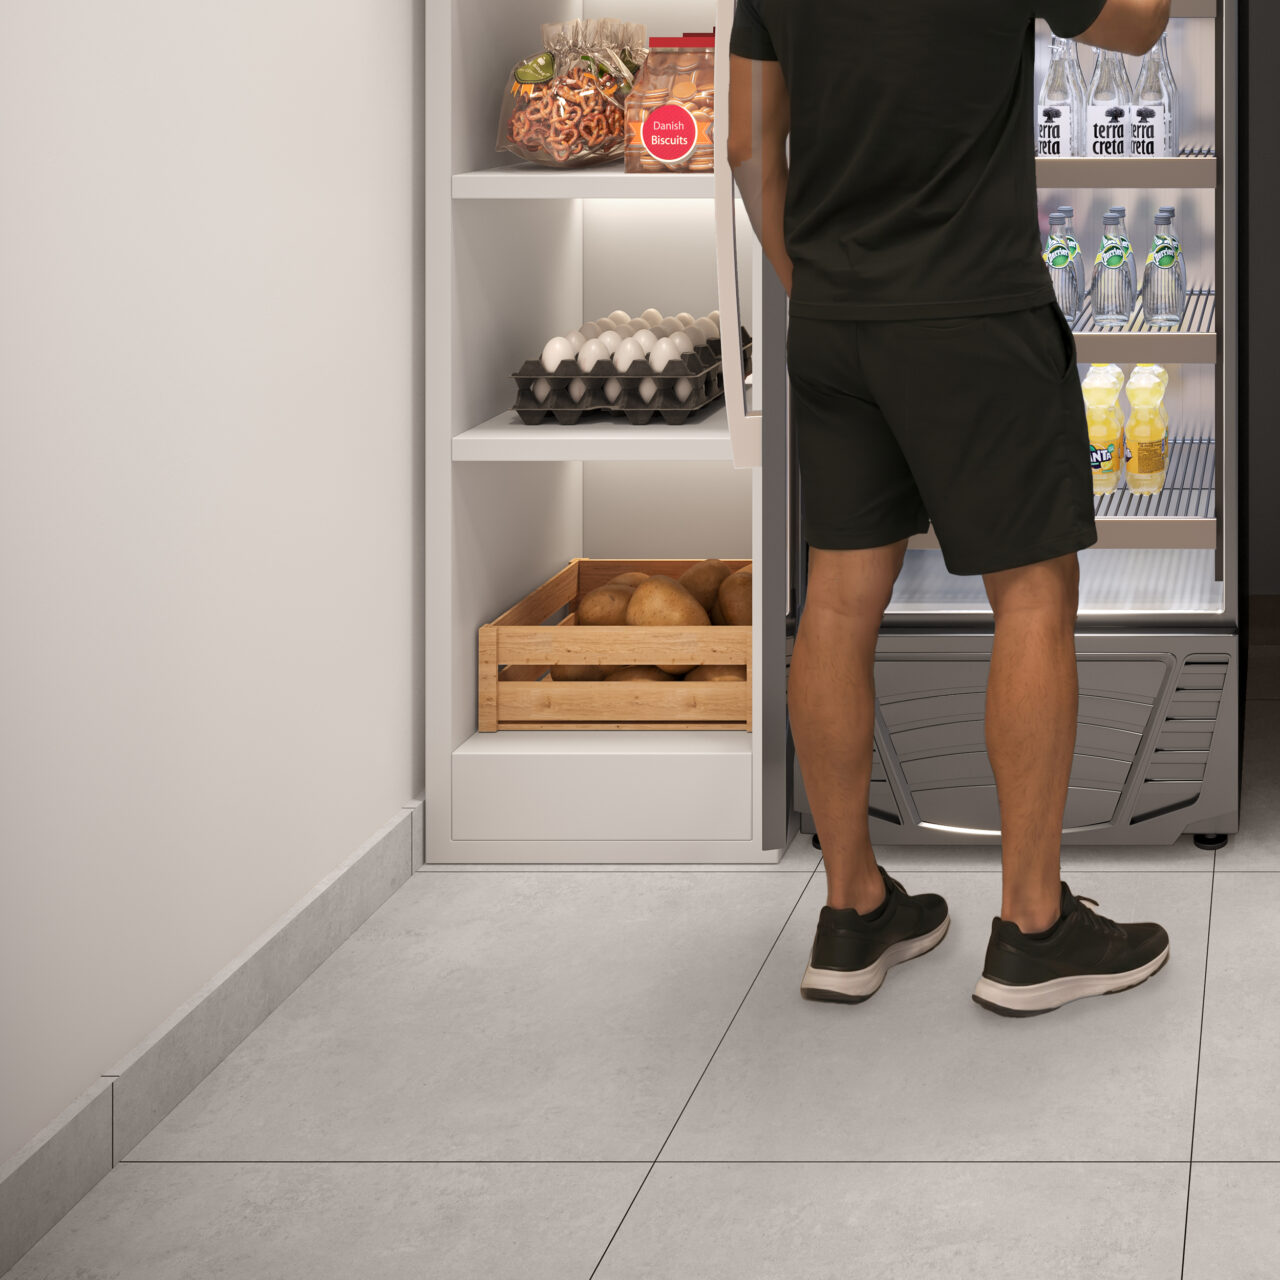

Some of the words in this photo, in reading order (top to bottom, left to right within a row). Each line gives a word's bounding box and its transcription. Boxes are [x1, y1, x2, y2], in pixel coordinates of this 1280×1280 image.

[653, 121, 685, 130] Danish
[1093, 123, 1124, 139] terra
[651, 135, 688, 145] Biscuits
[1092, 140, 1124, 155] creta
